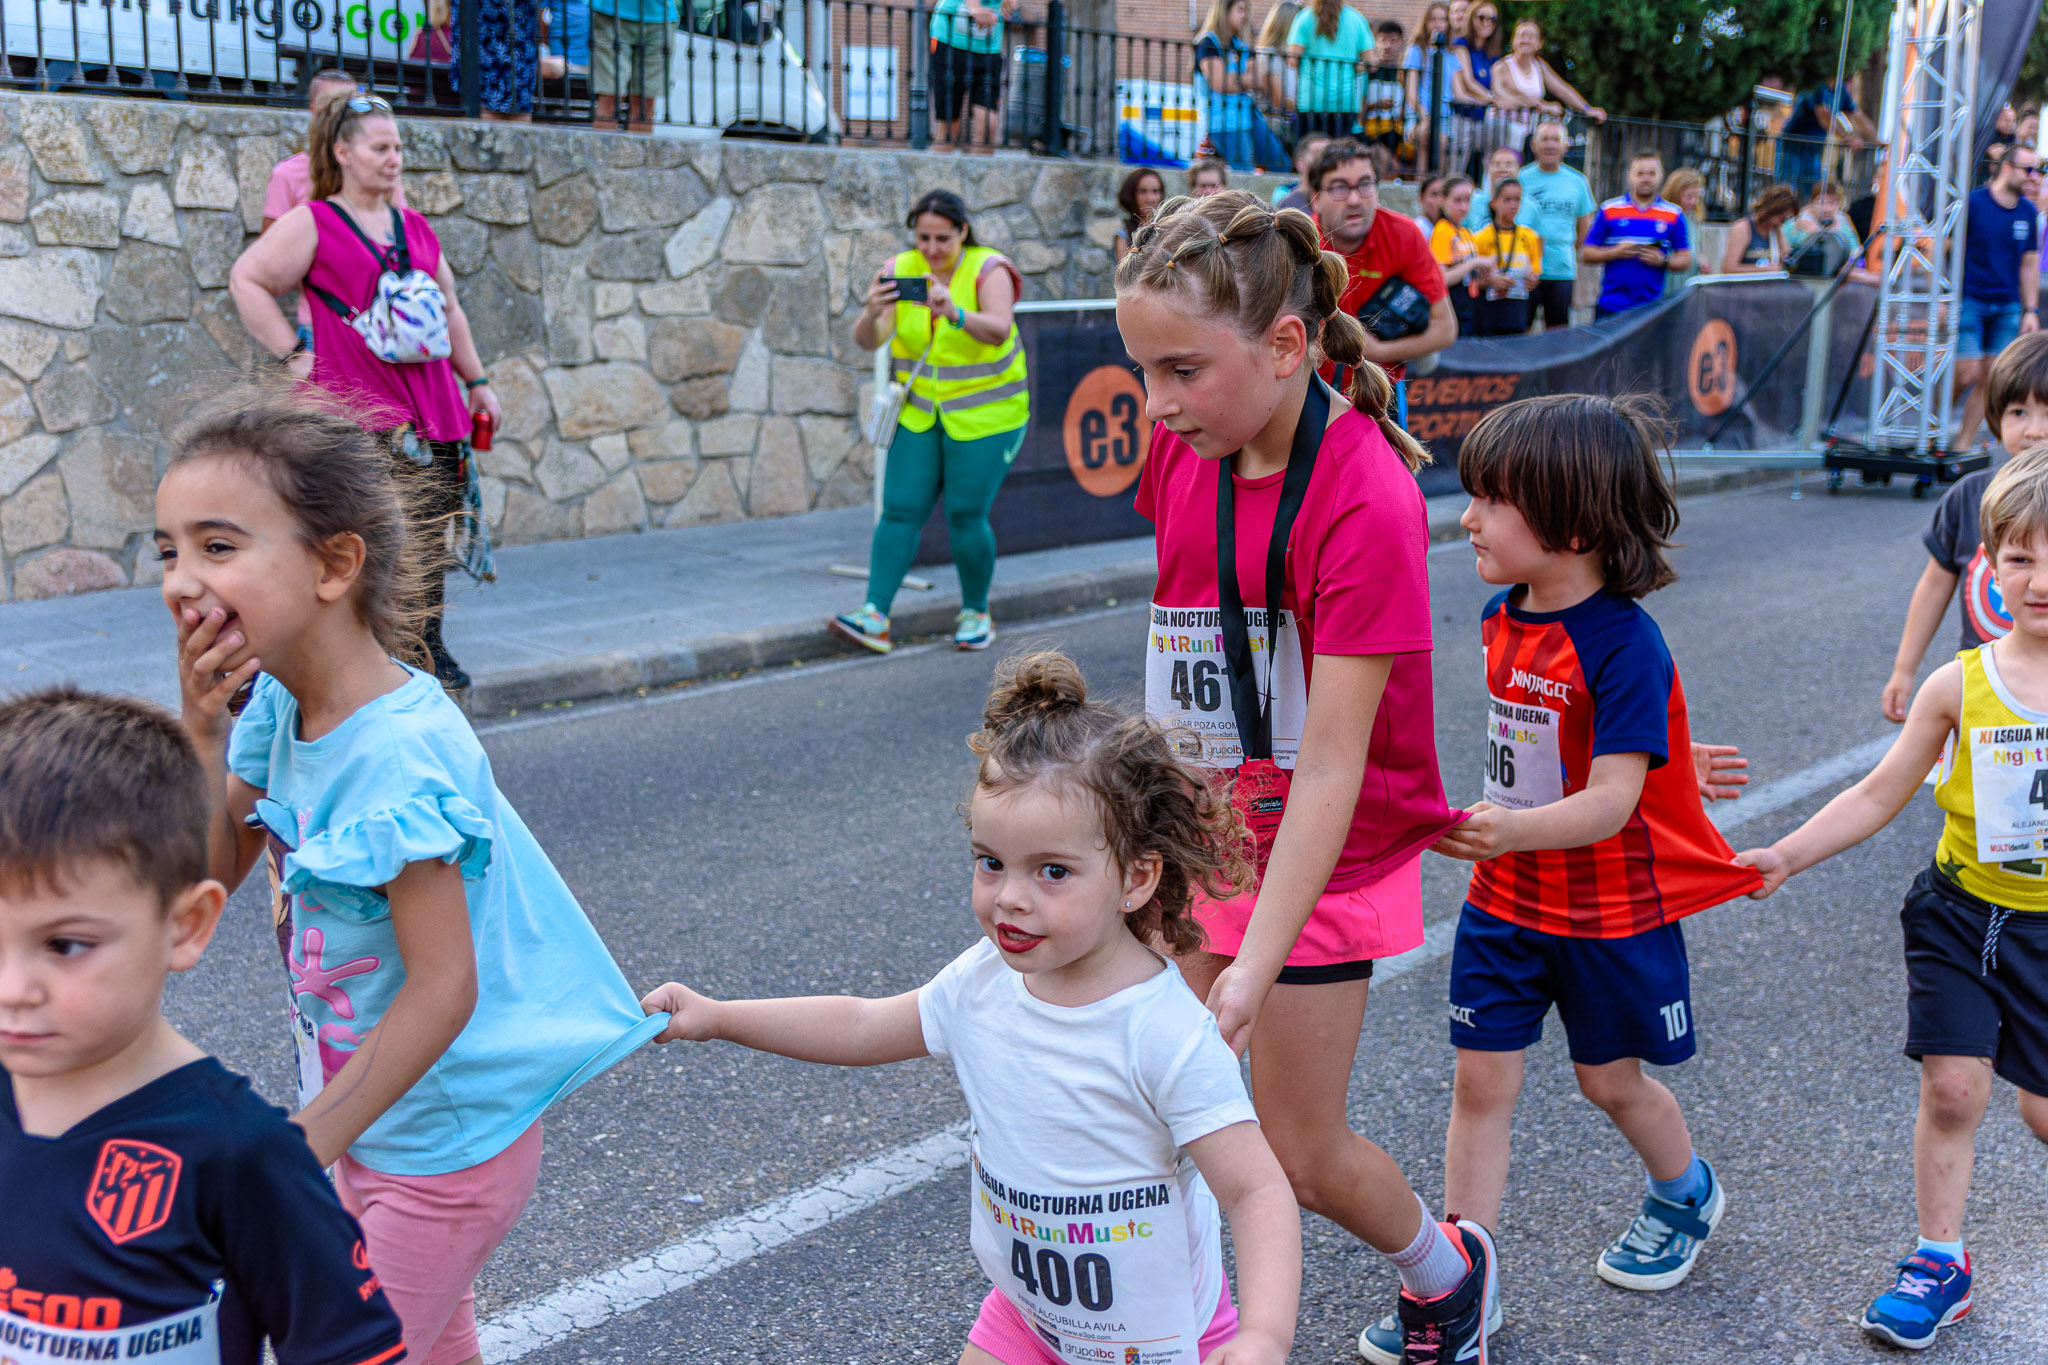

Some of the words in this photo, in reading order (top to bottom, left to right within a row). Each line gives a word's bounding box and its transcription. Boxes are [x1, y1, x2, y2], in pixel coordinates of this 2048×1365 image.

[1408, 374, 1520, 407] EVENTOS
[1080, 392, 1140, 470] e3
[1171, 611, 1222, 628] NOCTUR
[1194, 721, 1217, 729] POZA
[1218, 721, 1238, 730] GOM
[1515, 707, 1550, 726] UGENA
[1979, 730, 1993, 744] XI
[1994, 729, 2033, 744] LEGUA
[1486, 739, 1515, 788] 06
[1659, 999, 1689, 1042] 10
[979, 1161, 1007, 1202] LEGUA
[1008, 1187, 1104, 1216] NOCTURNA
[1108, 1183, 1170, 1213] UGENA
[1010, 1237, 1114, 1313] 400
[1038, 1307, 1092, 1331] ALCUBILLA
[1093, 1322, 1127, 1332] AVILA
[0, 1317, 121, 1361] OCTURNA
[126, 1314, 203, 1359] UGENA
[1064, 1342, 1116, 1360] grupoibc
